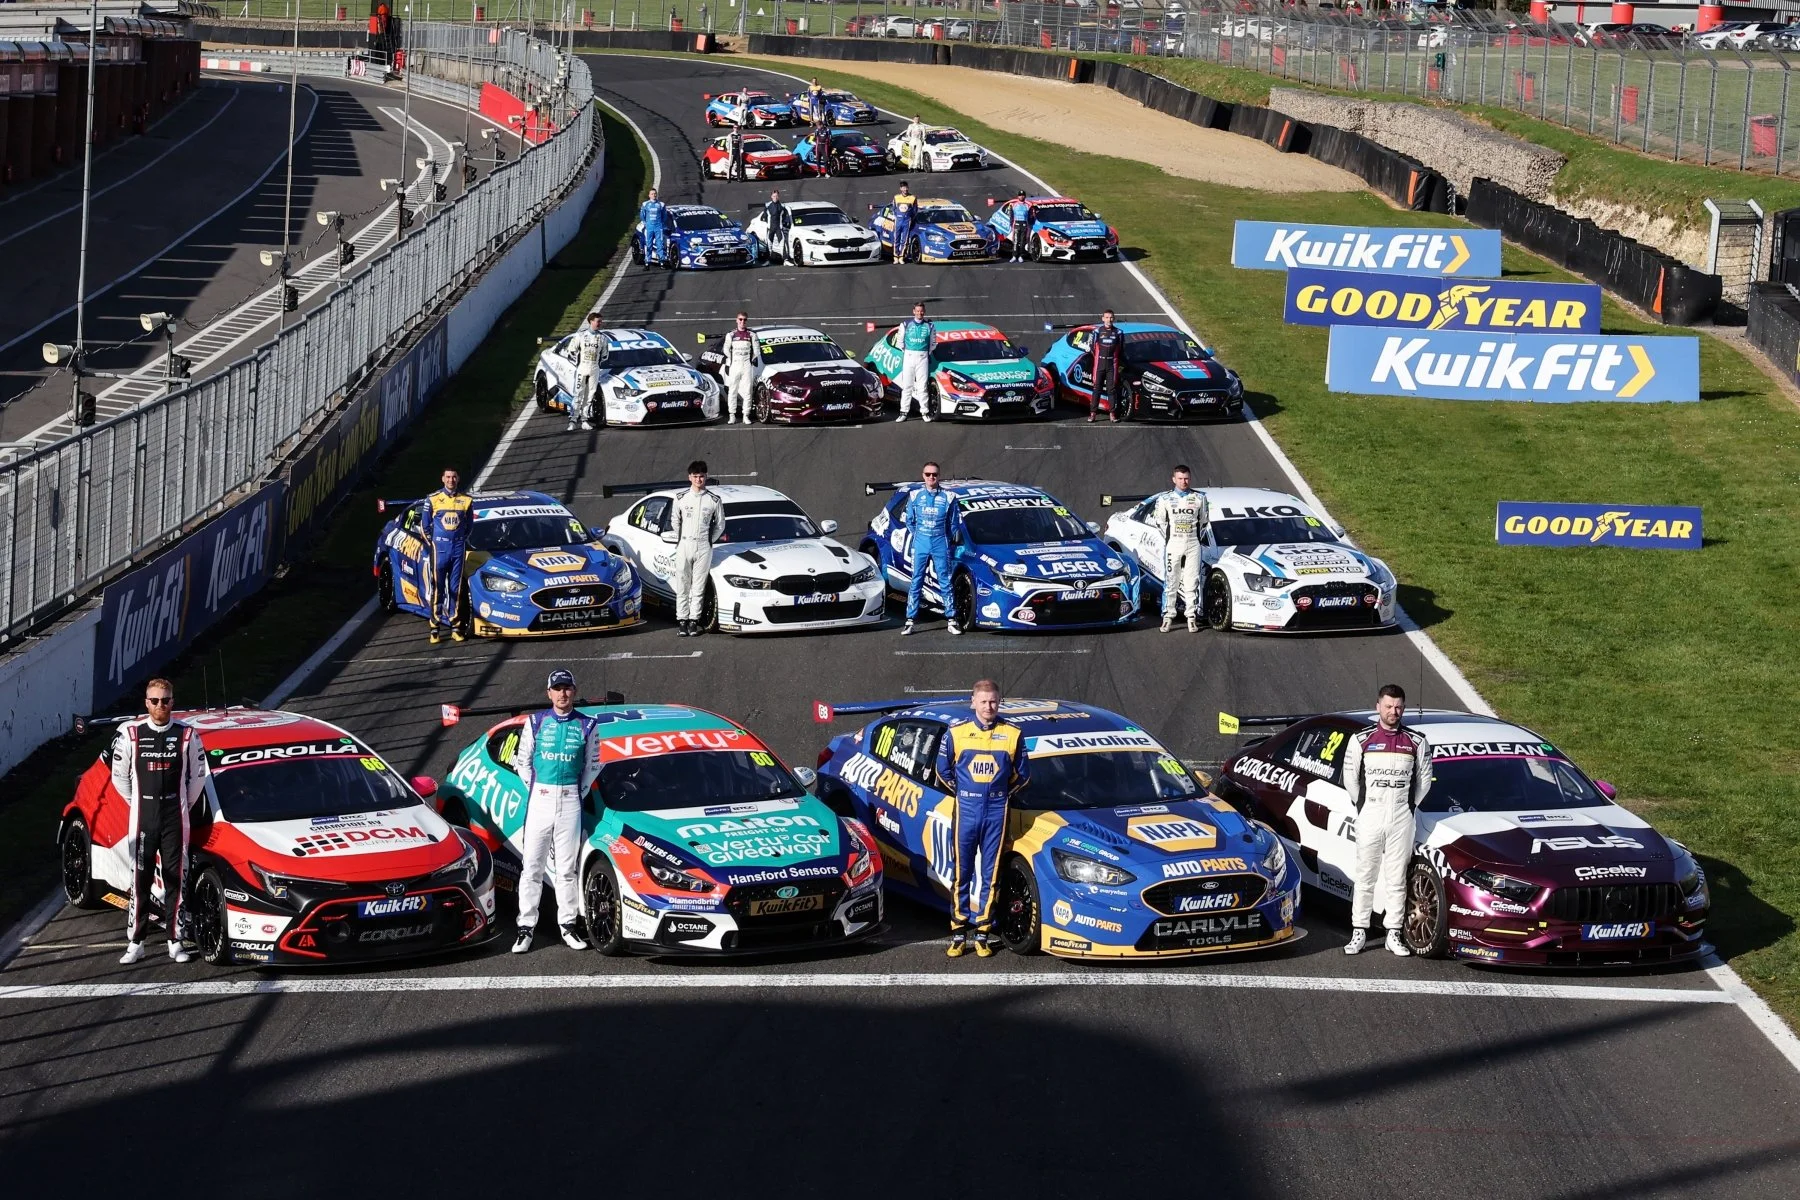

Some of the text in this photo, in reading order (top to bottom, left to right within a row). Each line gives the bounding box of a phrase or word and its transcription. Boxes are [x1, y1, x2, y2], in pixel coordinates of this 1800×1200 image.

[608, 341, 662, 351] LKQ
[766, 335, 824, 344] CATACLEAN
[804, 369, 854, 378] ASUS
[494, 508, 565, 516] Valvoline
[1221, 505, 1306, 518] LKQ
[536, 556, 580, 566] NAPA
[1037, 560, 1104, 576] LASER
[544, 574, 600, 586] AUTO PARTS
[492, 610, 520, 622] AUTO PARTS
[539, 608, 610, 623] CARLYLE
[1020, 612, 1034, 620] STP
[500, 732, 518, 764] 80
[875, 725, 896, 758] 116
[1045, 735, 1151, 749] Valvoline
[1320, 731, 1344, 761] 32
[220, 744, 358, 766] COROLLA
[1432, 743, 1545, 758] ATACLEAN
[360, 757, 386, 771] 66
[750, 752, 774, 766] 80
[890, 745, 915, 776] Sutton
[973, 762, 995, 774] NAPA
[1158, 758, 1186, 776] 116
[1367, 768, 1410, 776] CATACLEAN
[1234, 756, 1300, 794] CATACLEAN
[840, 752, 924, 818] AUTO PARTS
[1370, 780, 1406, 788] ASUS
[310, 820, 366, 832] CHAMPION
[725, 828, 769, 838] FREIGHT
[1138, 822, 1210, 842] NAPA
[344, 826, 428, 842] DCM
[793, 834, 831, 844] Car
[1069, 838, 1081, 847] THE
[1098, 849, 1120, 861] GROUP
[1530, 836, 1645, 854] ASUS
[644, 840, 669, 859] MILLERS
[666, 854, 683, 866] OILS
[708, 842, 821, 864] Giveaway
[1162, 857, 1248, 878] AUTO PARTS
[1575, 865, 1648, 878] Ciceley
[728, 866, 839, 886] Hansford Sensors
[1320, 871, 1352, 896] Ciceley
[1100, 888, 1128, 896] everywhen
[668, 897, 720, 906] Diamondbrite
[854, 902, 874, 912] OCTANE
[1490, 900, 1530, 914] Ciceley
[1054, 906, 1070, 920] NAPA
[1450, 904, 1485, 918] Snap-on
[1074, 914, 1122, 933] AUTO PARTS
[1154, 913, 1262, 936] CARLYLE
[360, 923, 433, 942] COROLLA
[231, 942, 274, 951] COROLLA
[1187, 934, 1232, 946] TOOLS
